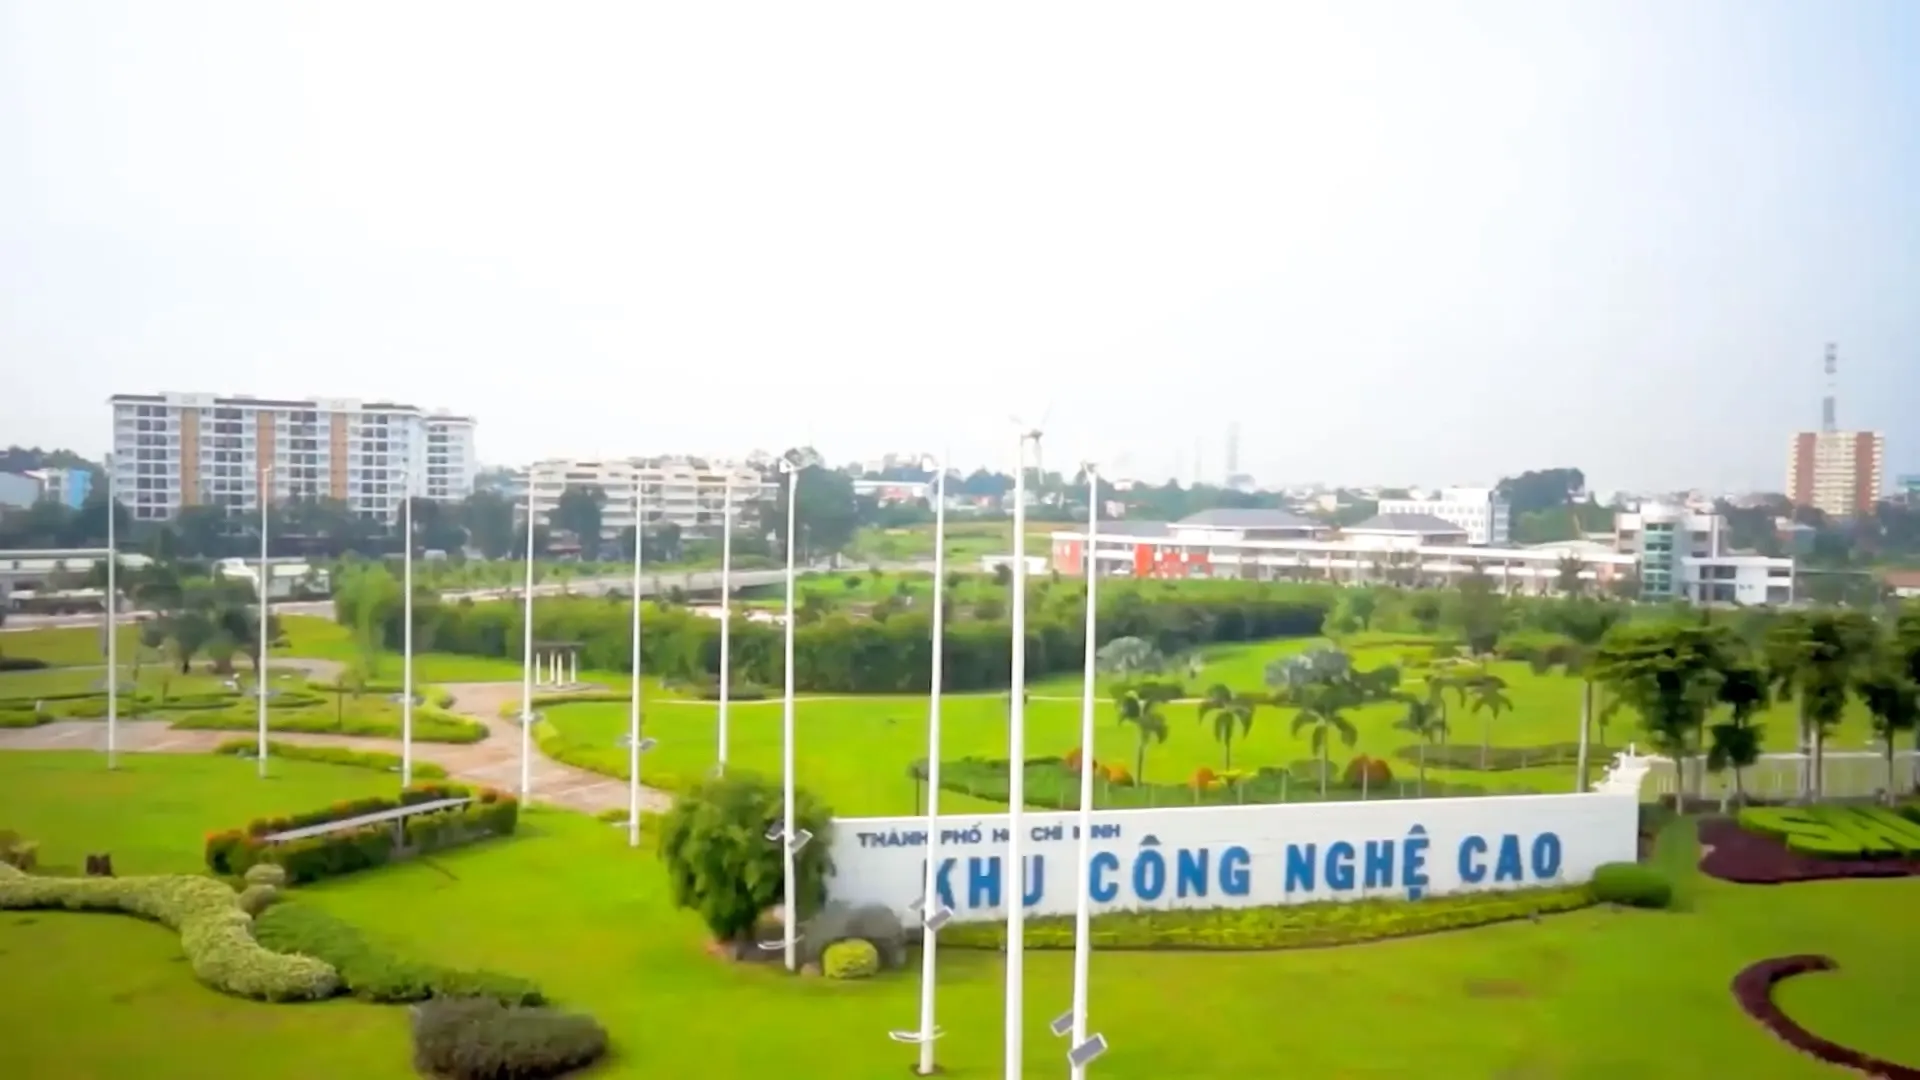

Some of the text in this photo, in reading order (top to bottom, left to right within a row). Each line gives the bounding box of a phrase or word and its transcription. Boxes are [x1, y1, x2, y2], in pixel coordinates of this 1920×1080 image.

[940, 822, 982, 845] PHỐ
[992, 828, 1012, 843] H
[923, 825, 1561, 909] KHU CÔNG NGHỆ CAO
